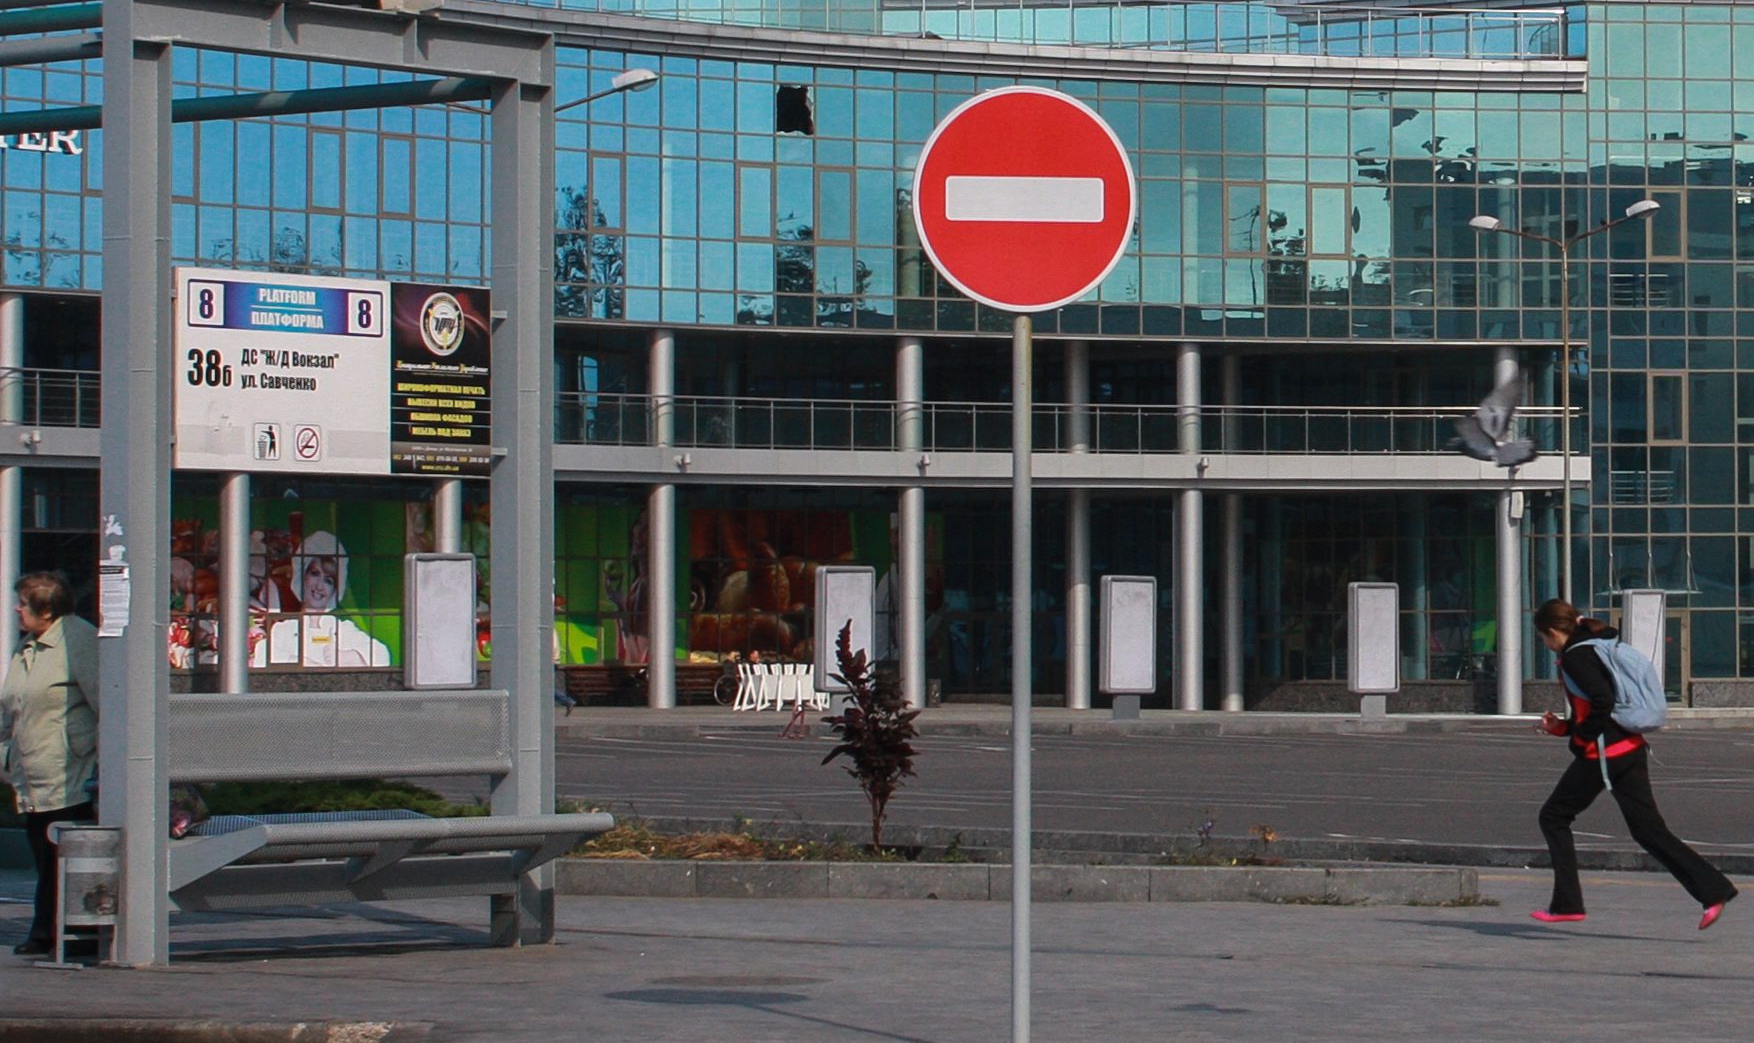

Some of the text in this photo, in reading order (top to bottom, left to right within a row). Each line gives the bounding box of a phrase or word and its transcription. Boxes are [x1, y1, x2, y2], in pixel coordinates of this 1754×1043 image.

[198, 288, 215, 320] 8
[258, 287, 316, 306] PLATFORM
[251, 311, 324, 330] ПЛАТФОРМА
[357, 298, 373, 329] 8
[187, 347, 233, 388] 38б
[241, 348, 259, 367] ДС
[292, 350, 340, 369] Вокзал"
[241, 372, 317, 392] ул. Савченко
